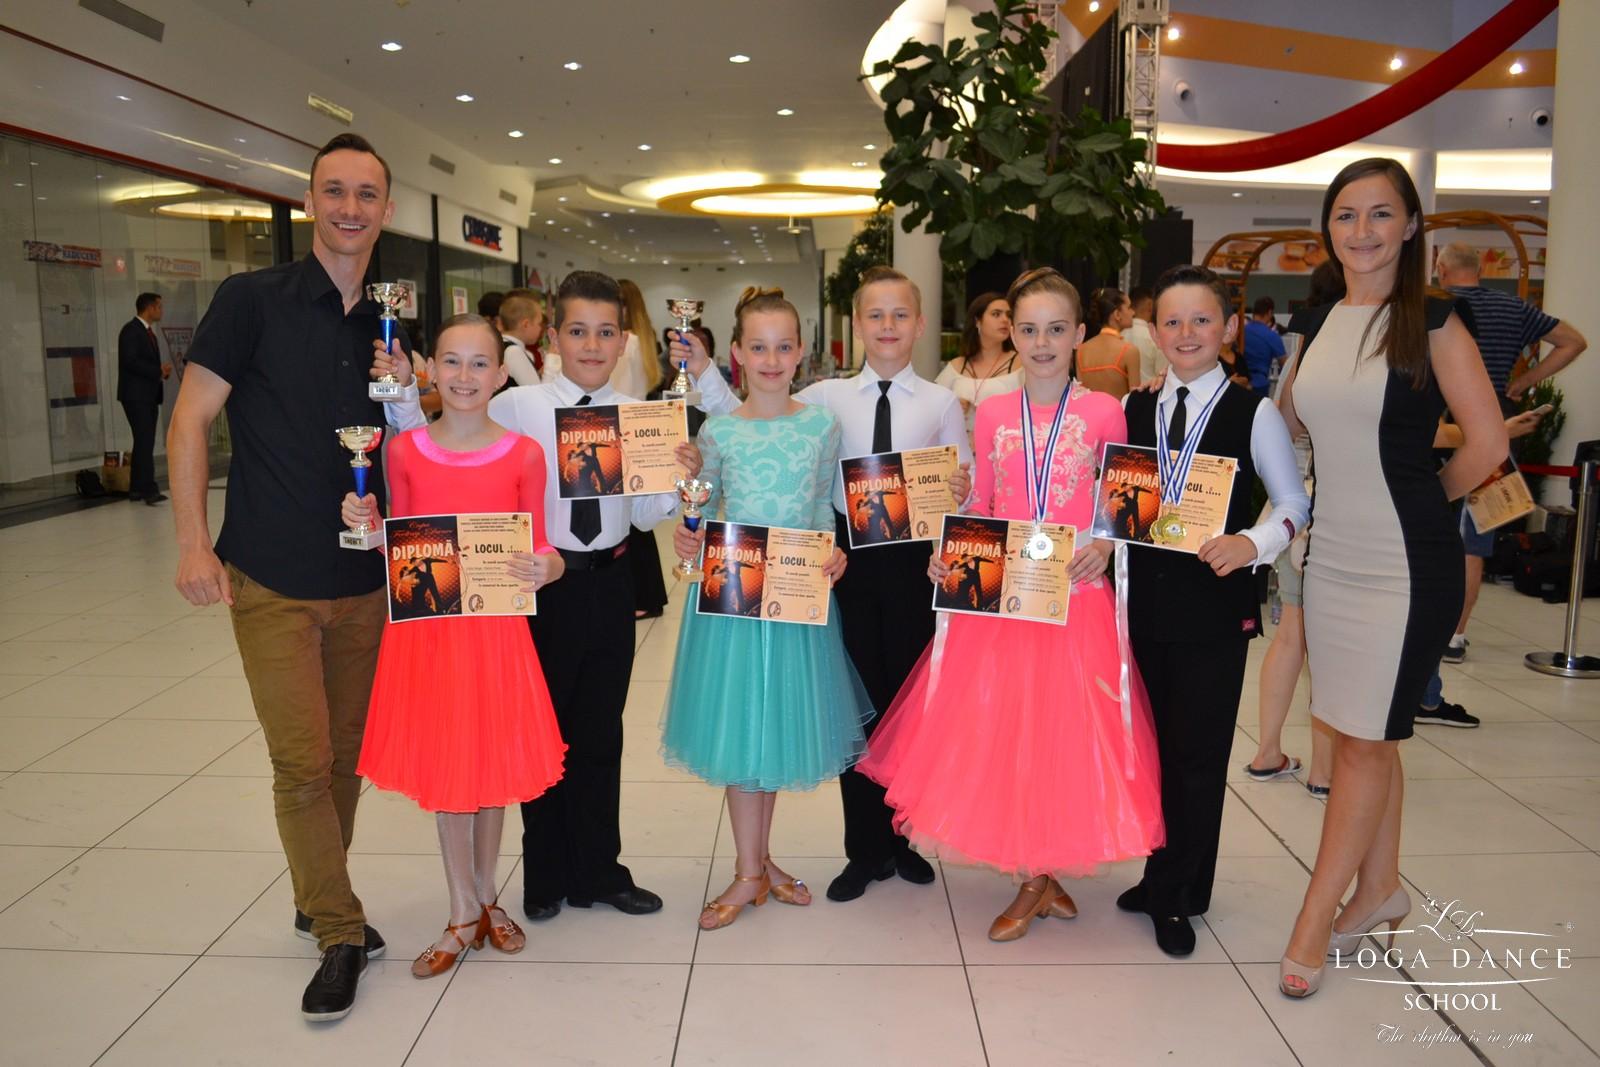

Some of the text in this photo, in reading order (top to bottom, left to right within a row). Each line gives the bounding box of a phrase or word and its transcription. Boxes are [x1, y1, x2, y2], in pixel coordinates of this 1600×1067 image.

[561, 425, 616, 444] DIPLOMĂ
[634, 428, 661, 439] LOCUL
[848, 473, 902, 495] DIPLOMĂ
[917, 473, 942, 485] LOCUL
[392, 539, 455, 562] DIPLOMĂ
[475, 543, 504, 554] LOCUL
[707, 545, 762, 563] DIPLOMĂ
[946, 540, 1002, 558] DIPLOMĂ
[780, 554, 807, 567] LOCUL
